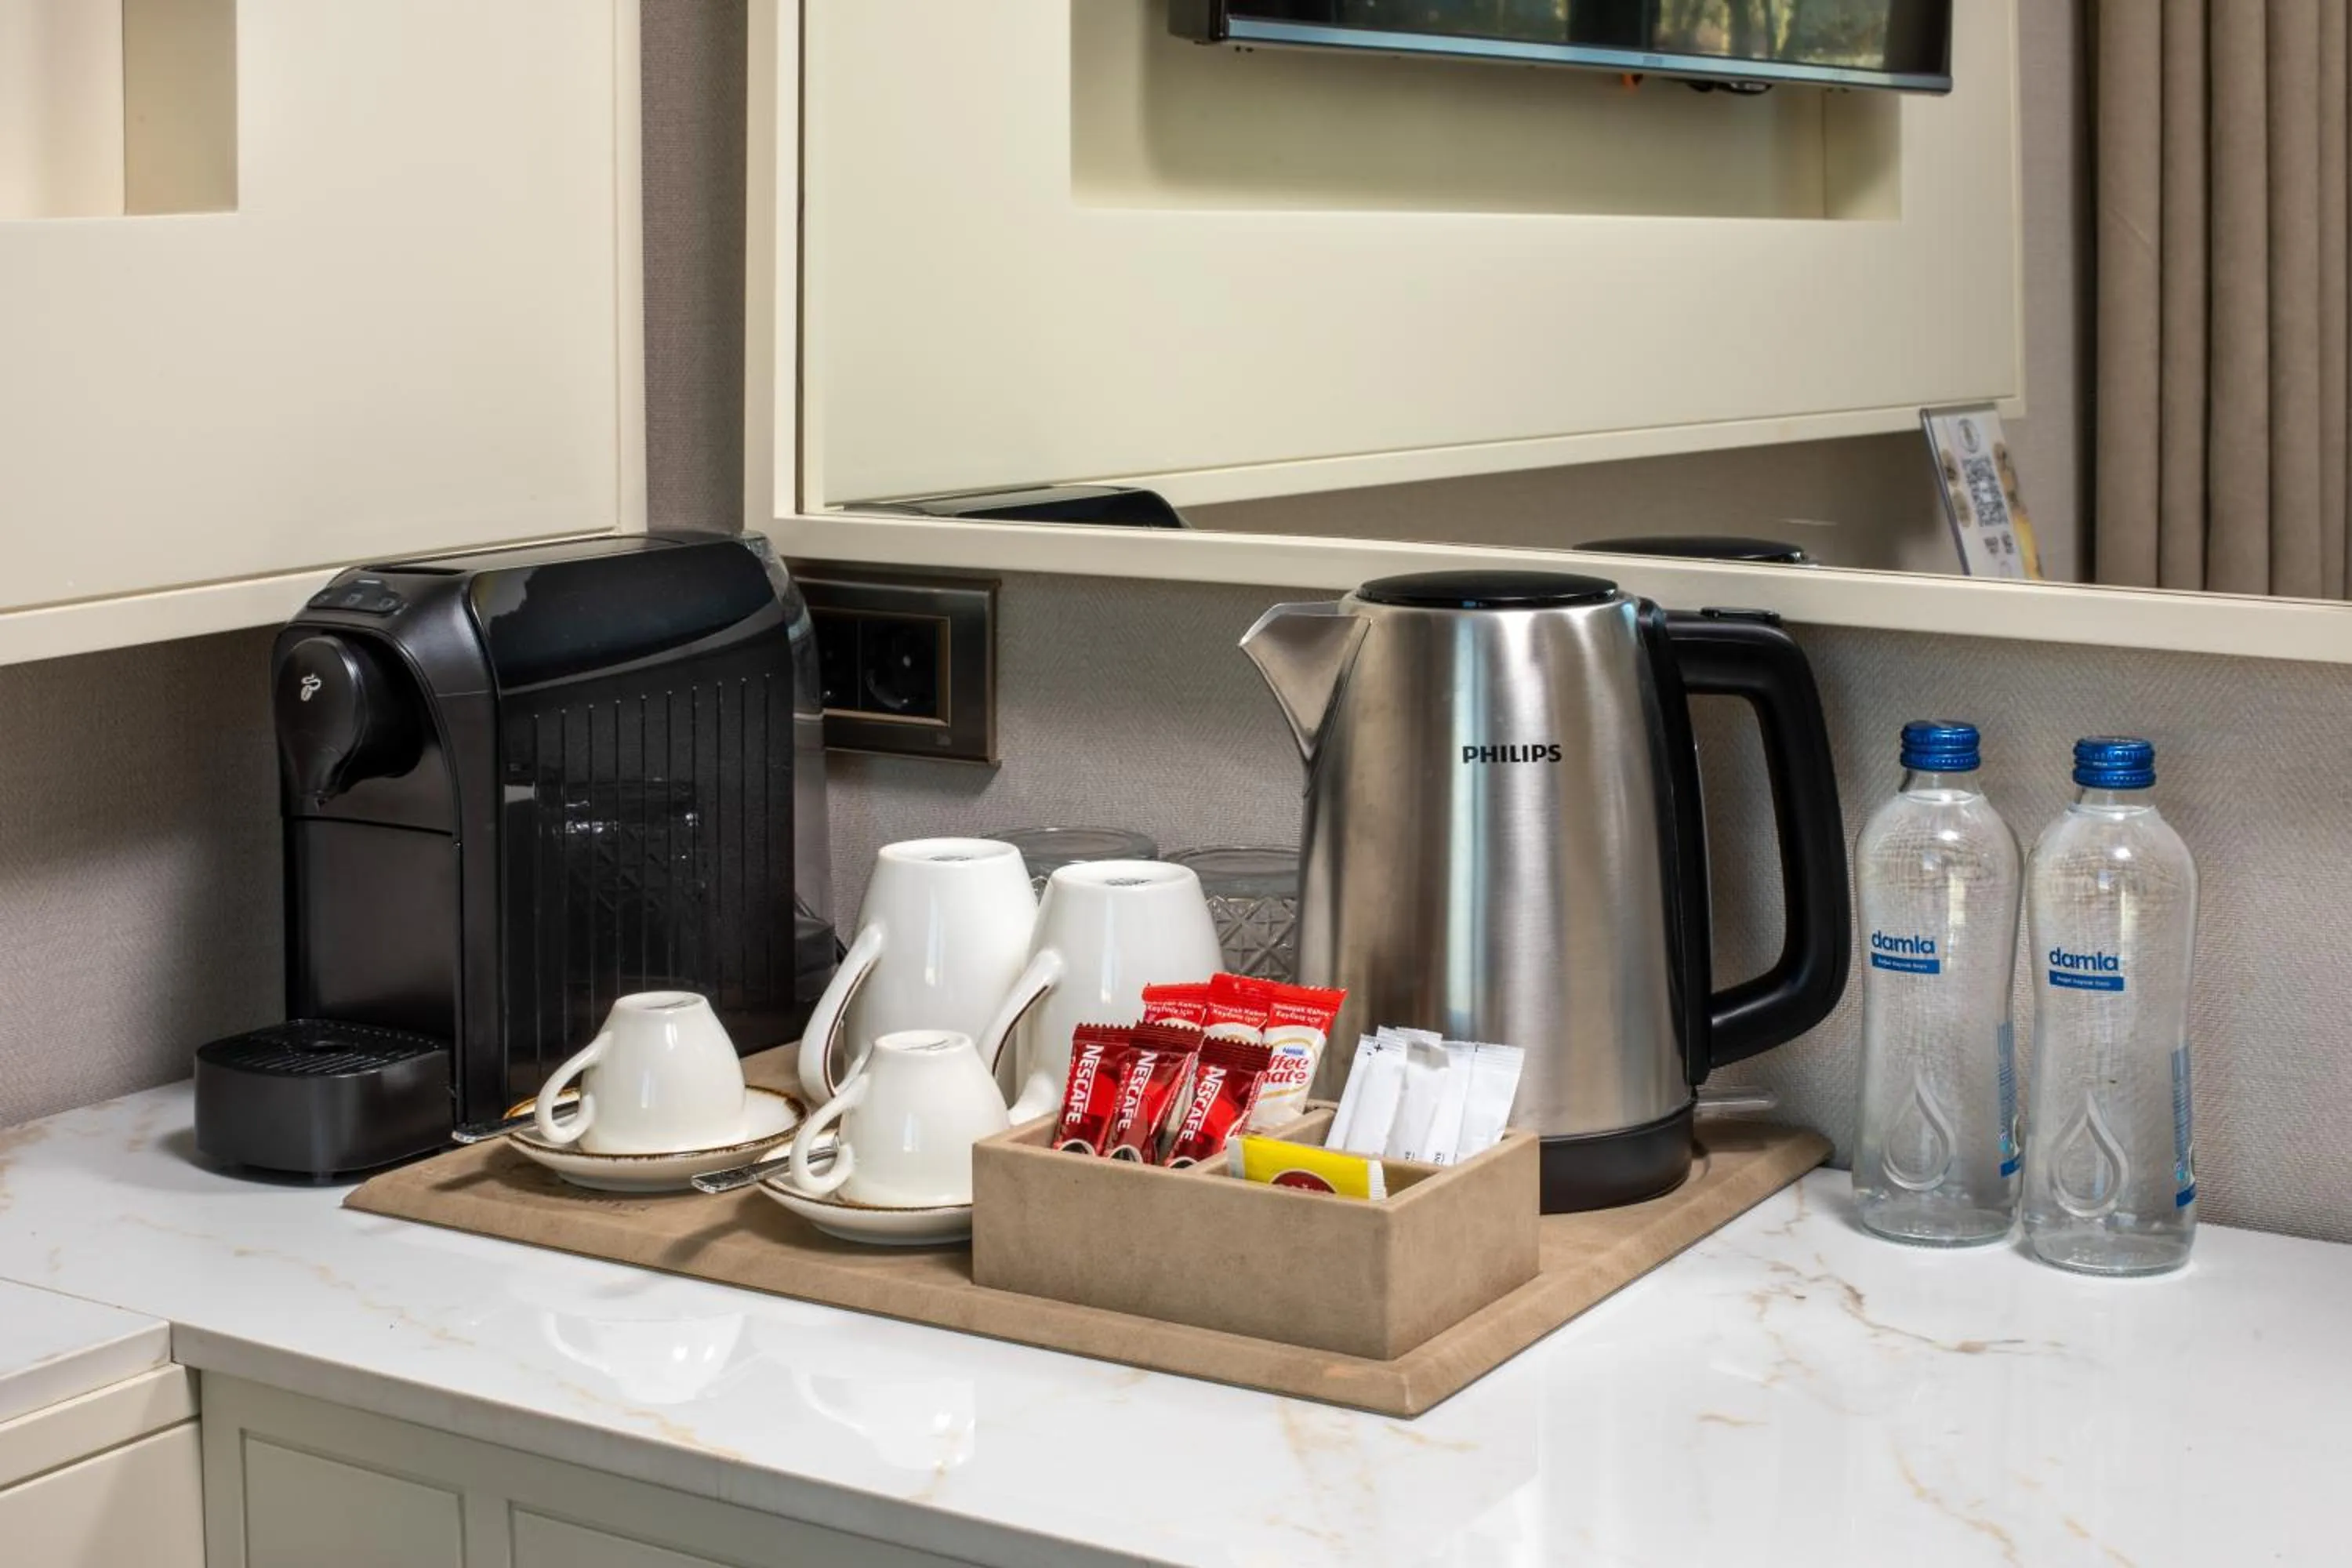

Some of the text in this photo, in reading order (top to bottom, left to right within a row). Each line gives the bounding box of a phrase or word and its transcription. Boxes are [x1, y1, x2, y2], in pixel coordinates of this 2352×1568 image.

[1462, 744, 1562, 763] PHILIPS
[1871, 930, 1936, 954] damla
[2049, 946, 2119, 971] damla
[1267, 1054, 1309, 1070] ffee
